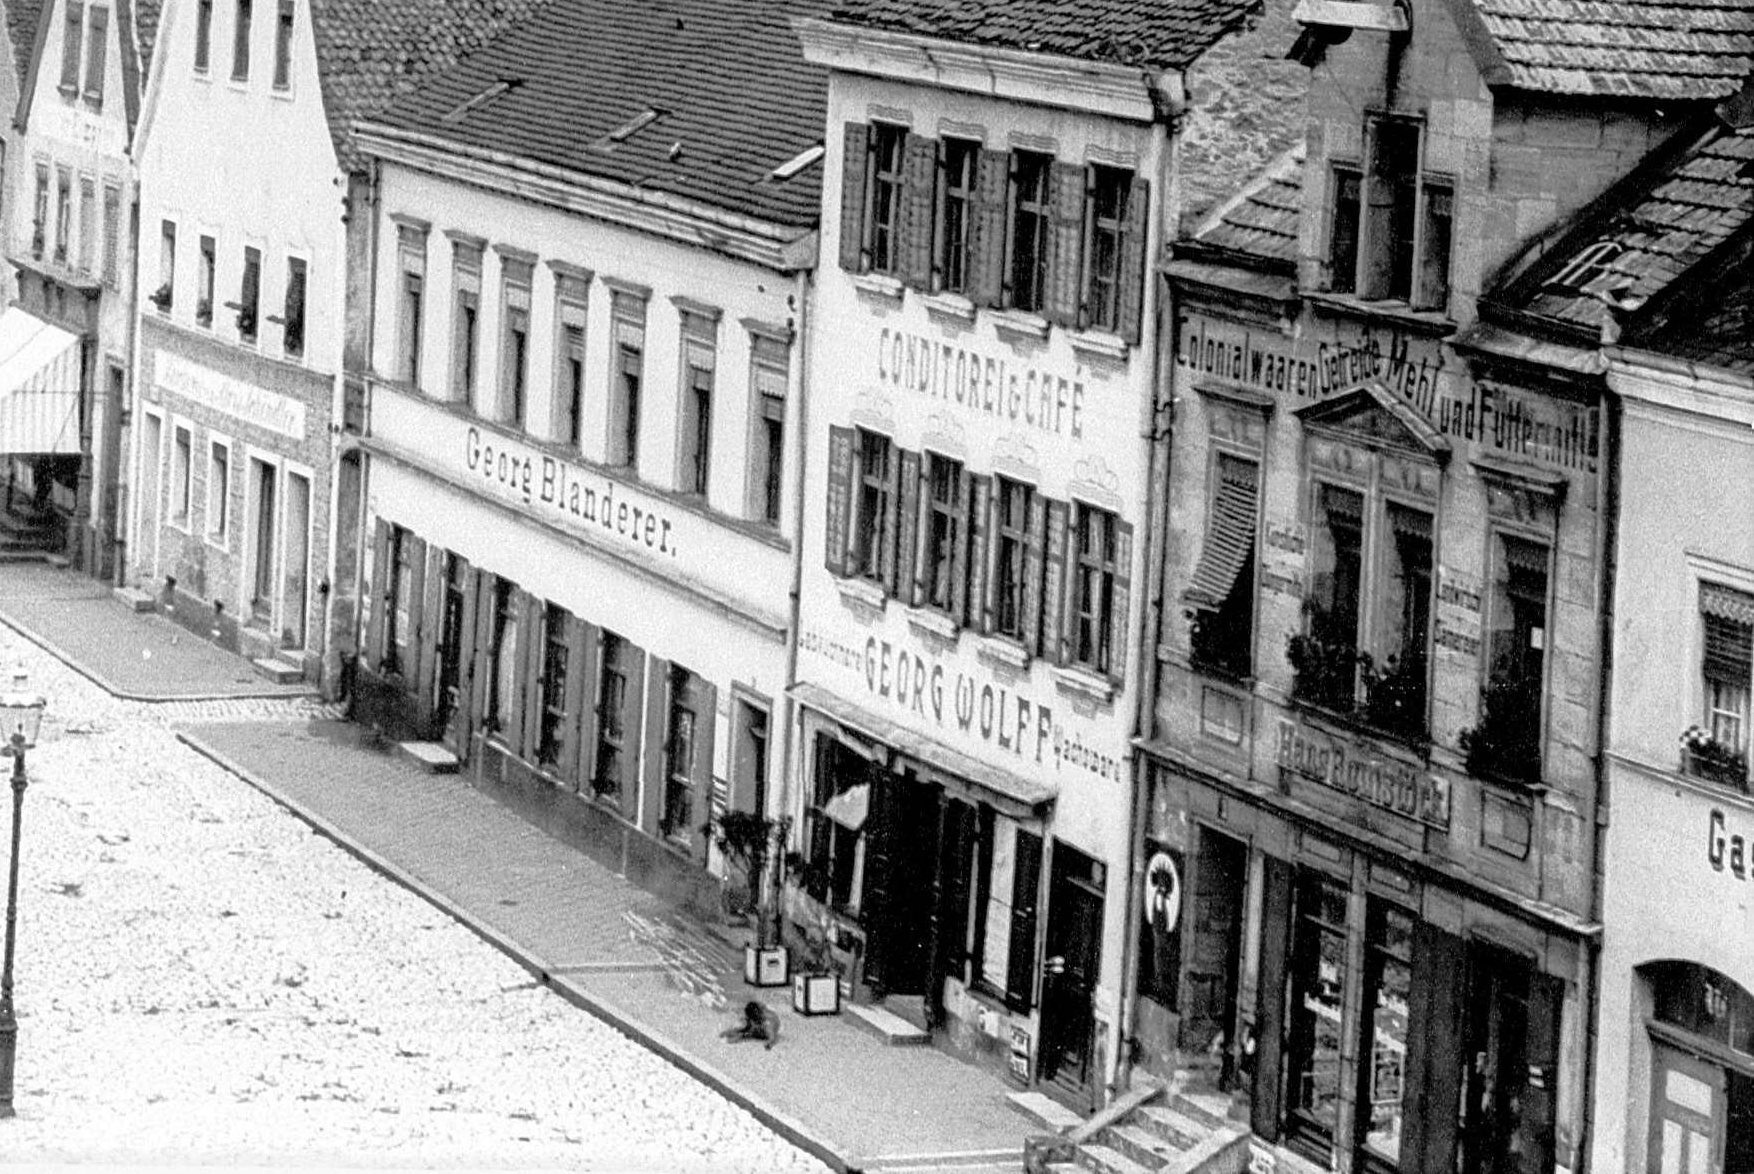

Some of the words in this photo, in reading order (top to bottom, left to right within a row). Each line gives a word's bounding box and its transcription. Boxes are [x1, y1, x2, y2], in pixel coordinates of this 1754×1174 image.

[879, 327, 1005, 416] CONDITOREI
[1025, 364, 1084, 439] CAFÉ
[1386, 330, 1445, 419] Mehl
[1440, 386, 1476, 440] und
[466, 427, 532, 504] Georg
[540, 456, 676, 557] Blanderer.
[865, 636, 944, 722] GEORG
[955, 673, 1052, 763] WOLFF
[1278, 721, 1329, 781] Hans
[1708, 808, 1754, 881] Ga
